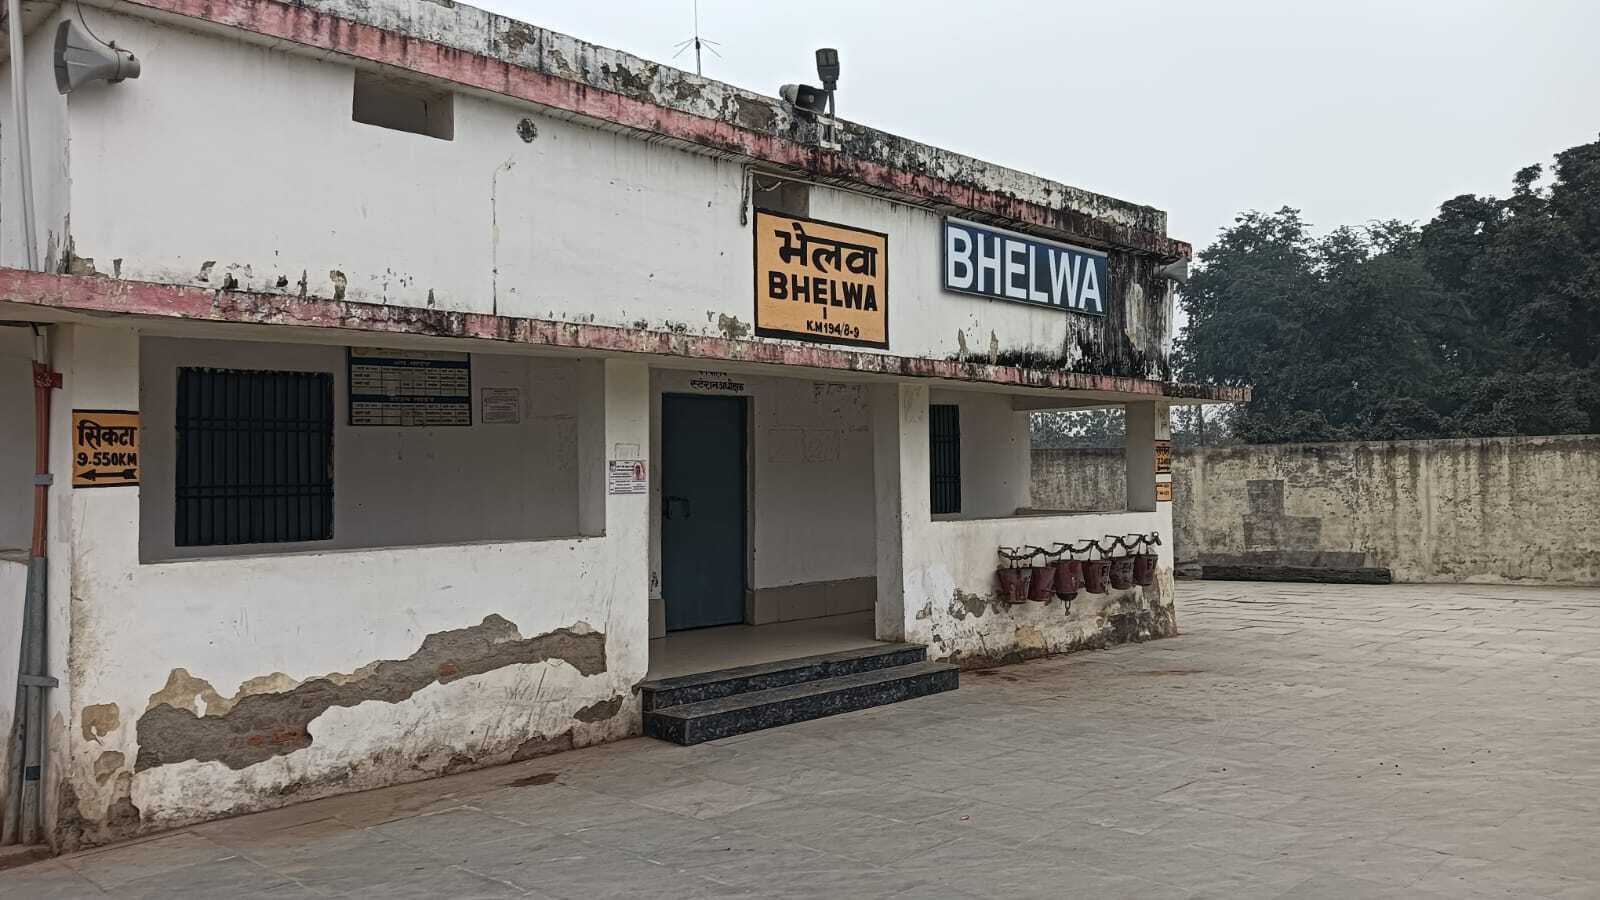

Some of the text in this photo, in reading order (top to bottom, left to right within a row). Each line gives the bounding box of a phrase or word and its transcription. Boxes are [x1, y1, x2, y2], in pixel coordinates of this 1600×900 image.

[774, 222, 878, 278] भेलवा
[947, 226, 1103, 313] BHELWA
[768, 270, 878, 312] BHELWA
[77, 419, 138, 450] सिकटा
